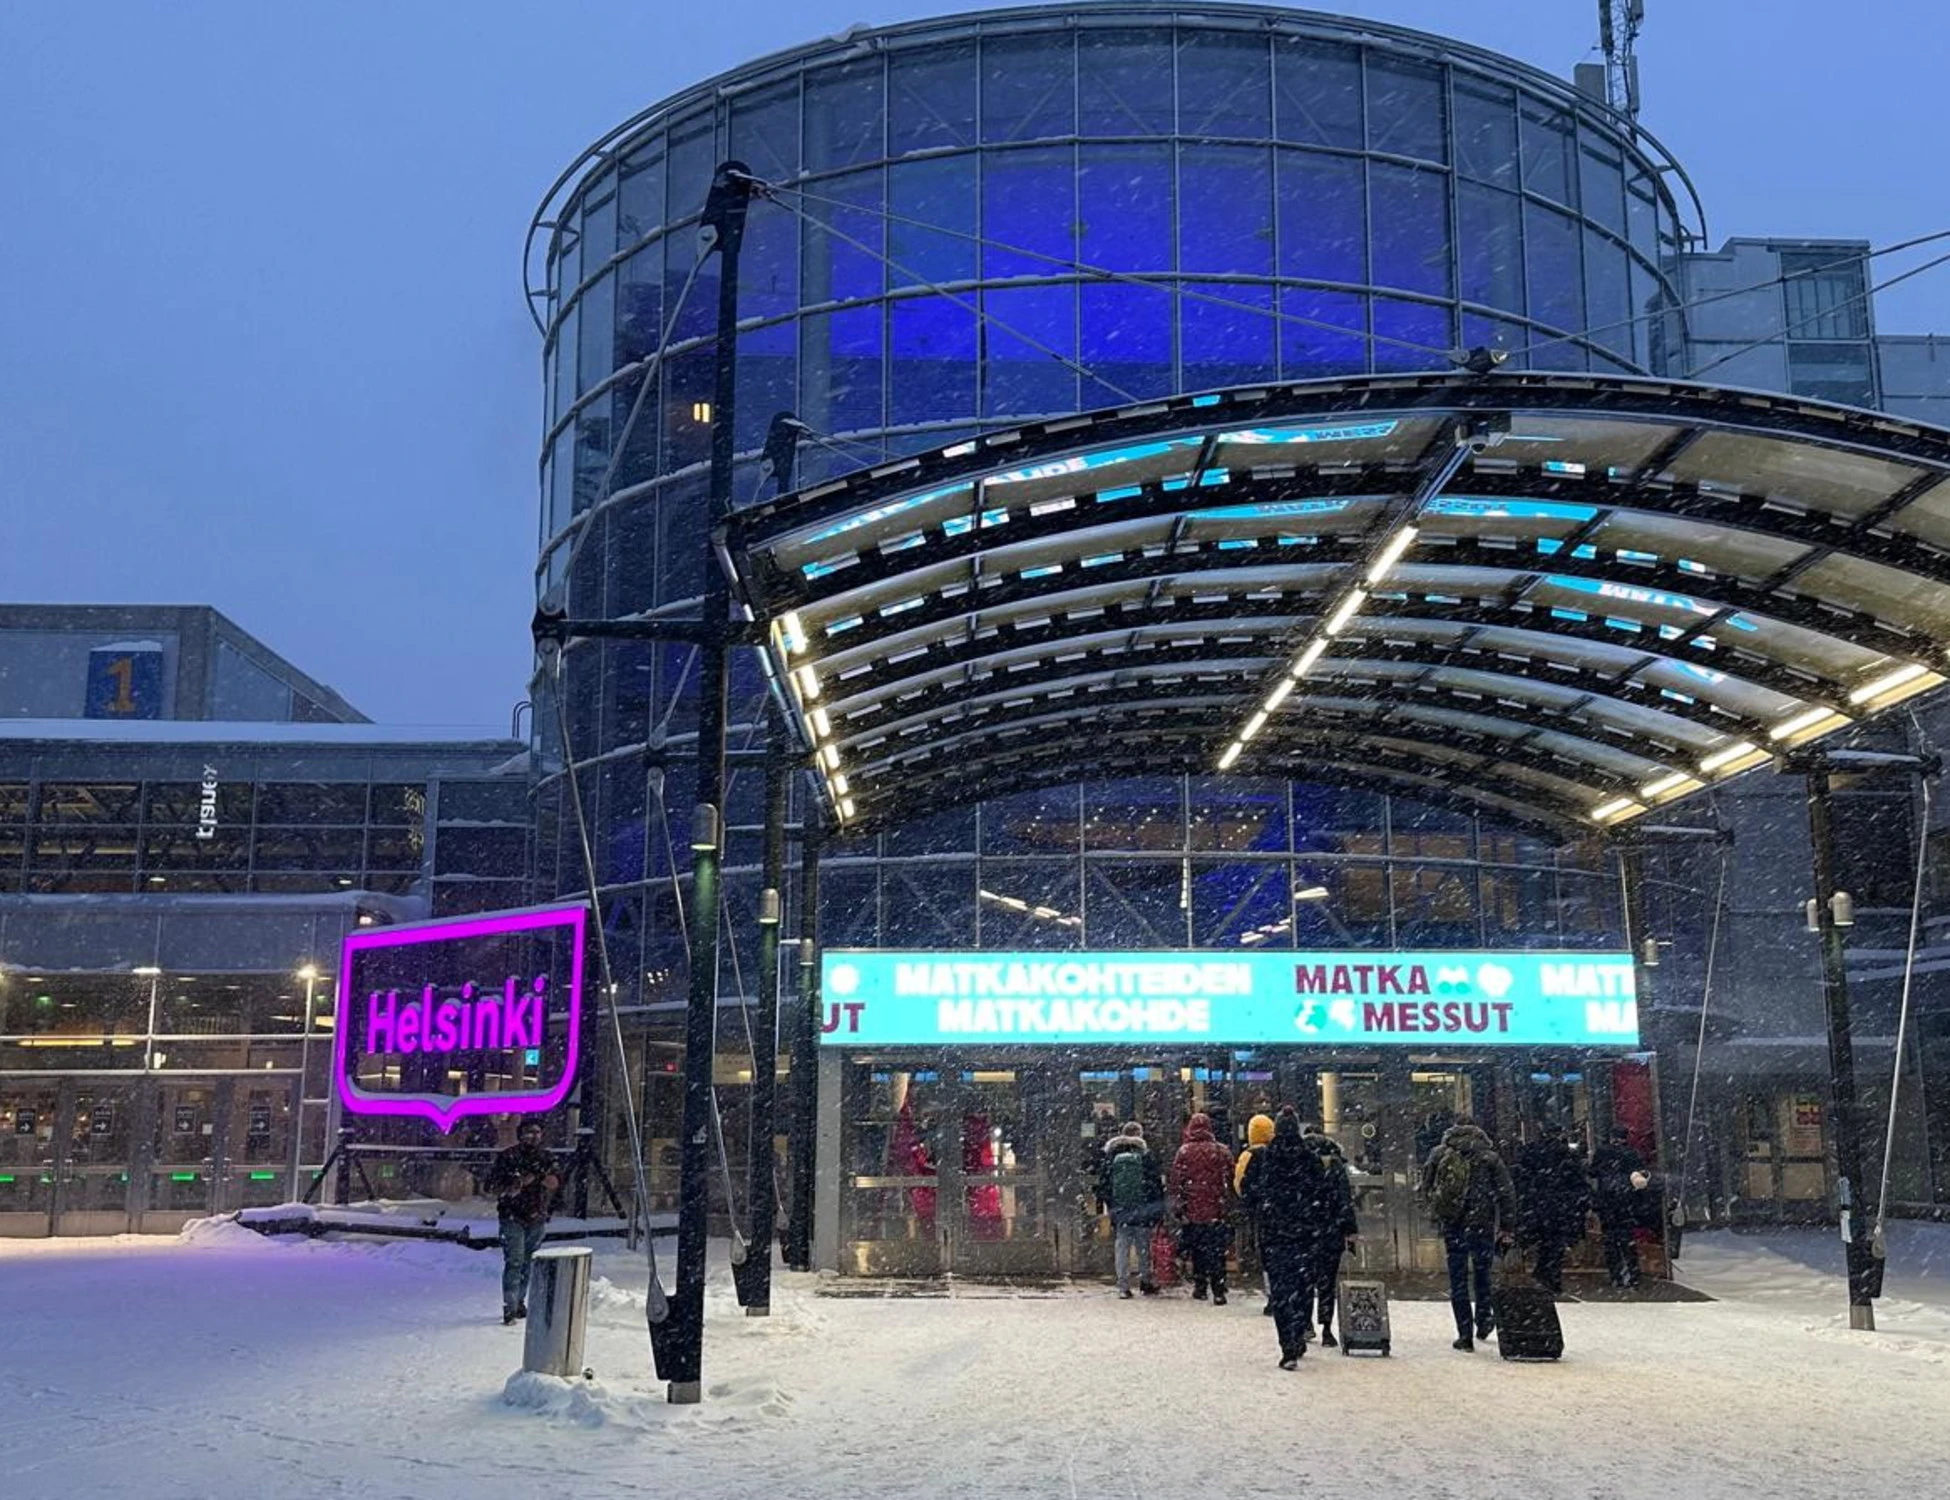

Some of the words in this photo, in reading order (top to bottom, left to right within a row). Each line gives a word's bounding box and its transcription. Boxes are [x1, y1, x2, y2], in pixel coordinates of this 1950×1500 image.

[106, 656, 136, 712] 1
[895, 962, 1253, 996] MATKAKOHTEIDEN
[1295, 964, 1431, 994] MATKA
[367, 974, 544, 1054] Helsinki
[938, 1000, 1211, 1033] MATKAKOHDE
[1363, 1002, 1513, 1033] MESSUT
